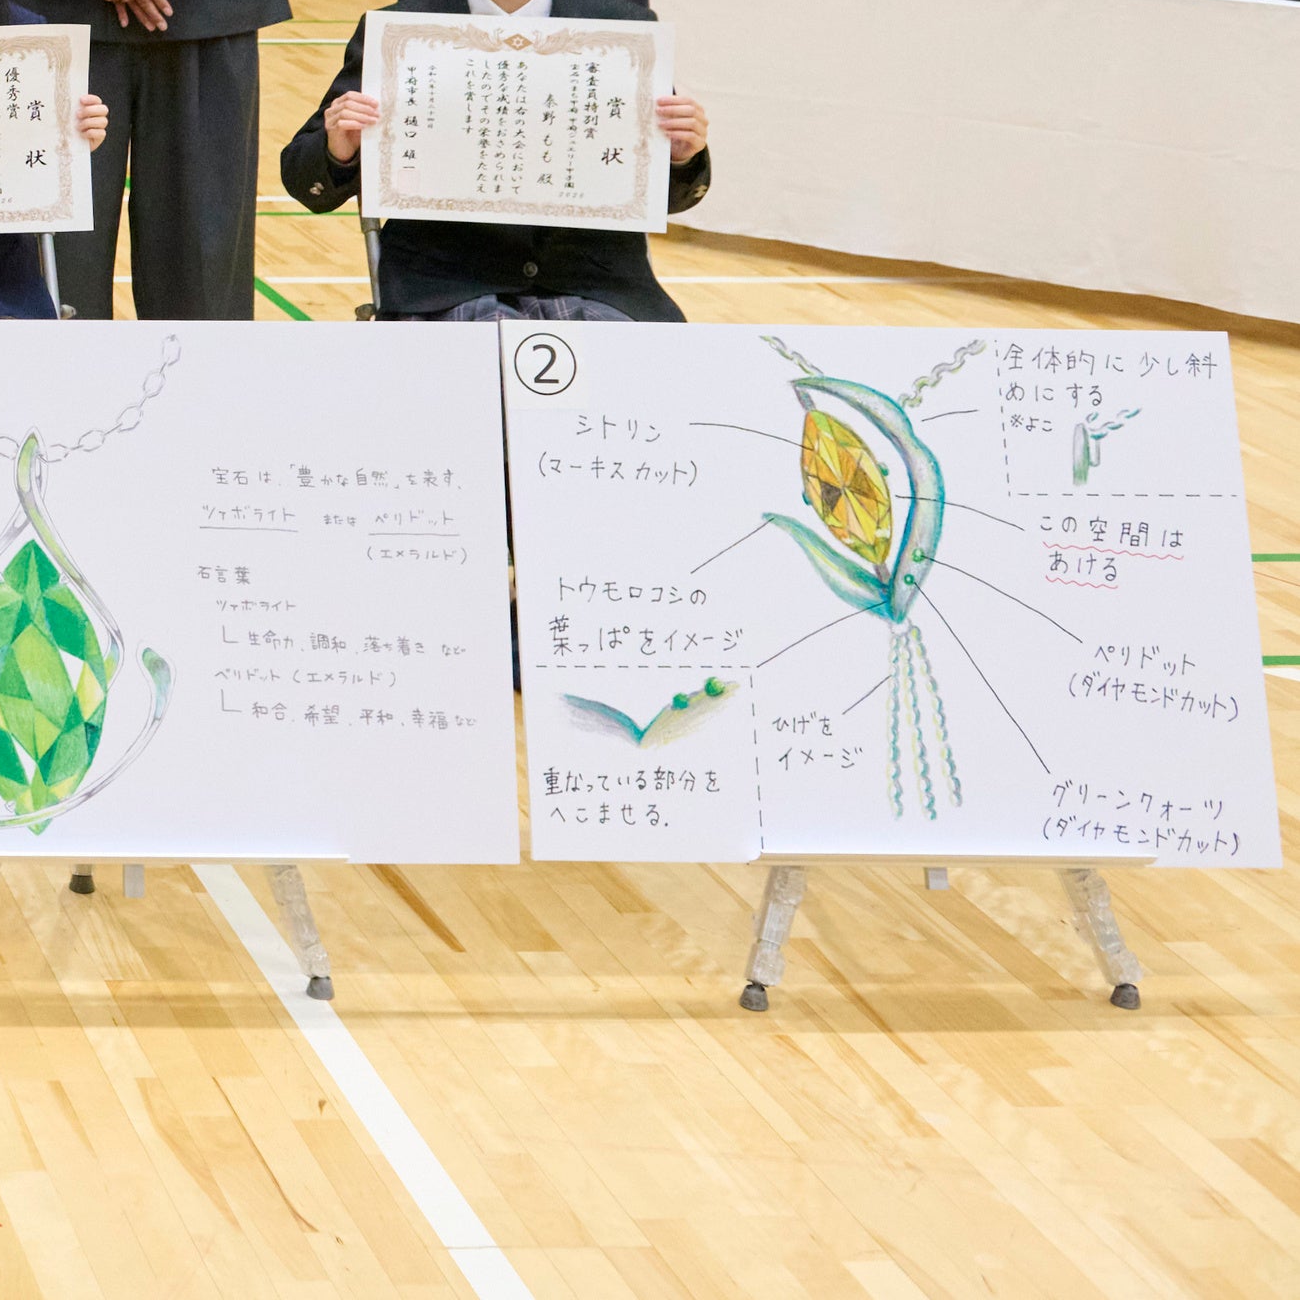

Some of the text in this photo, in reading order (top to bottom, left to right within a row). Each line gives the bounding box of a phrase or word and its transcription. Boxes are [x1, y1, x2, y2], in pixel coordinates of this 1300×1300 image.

[5, 67, 21, 120] 優秀賞
[405, 66, 417, 106] 甲府市長
[583, 62, 600, 140] 審査員特別賞
[1003, 343, 1217, 380] 全体的に少し斜
[1005, 382, 1103, 408] めにする
[576, 414, 661, 442] シトリン
[324, 514, 356, 526] または
[375, 509, 454, 526] ペリドット
[1040, 516, 1184, 548] この空間は
[198, 566, 251, 585] 石言葉
[1049, 550, 1118, 582] あける
[558, 576, 707, 605] トウモロコシの
[549, 614, 744, 657] 葉っぱをイメージ
[1094, 645, 1195, 676] ペリドット
[772, 711, 833, 737] ひげを
[778, 746, 863, 771] イメージ
[543, 766, 720, 796] 重なっている部分を
[1053, 780, 1223, 821] グリーンクォーツ
